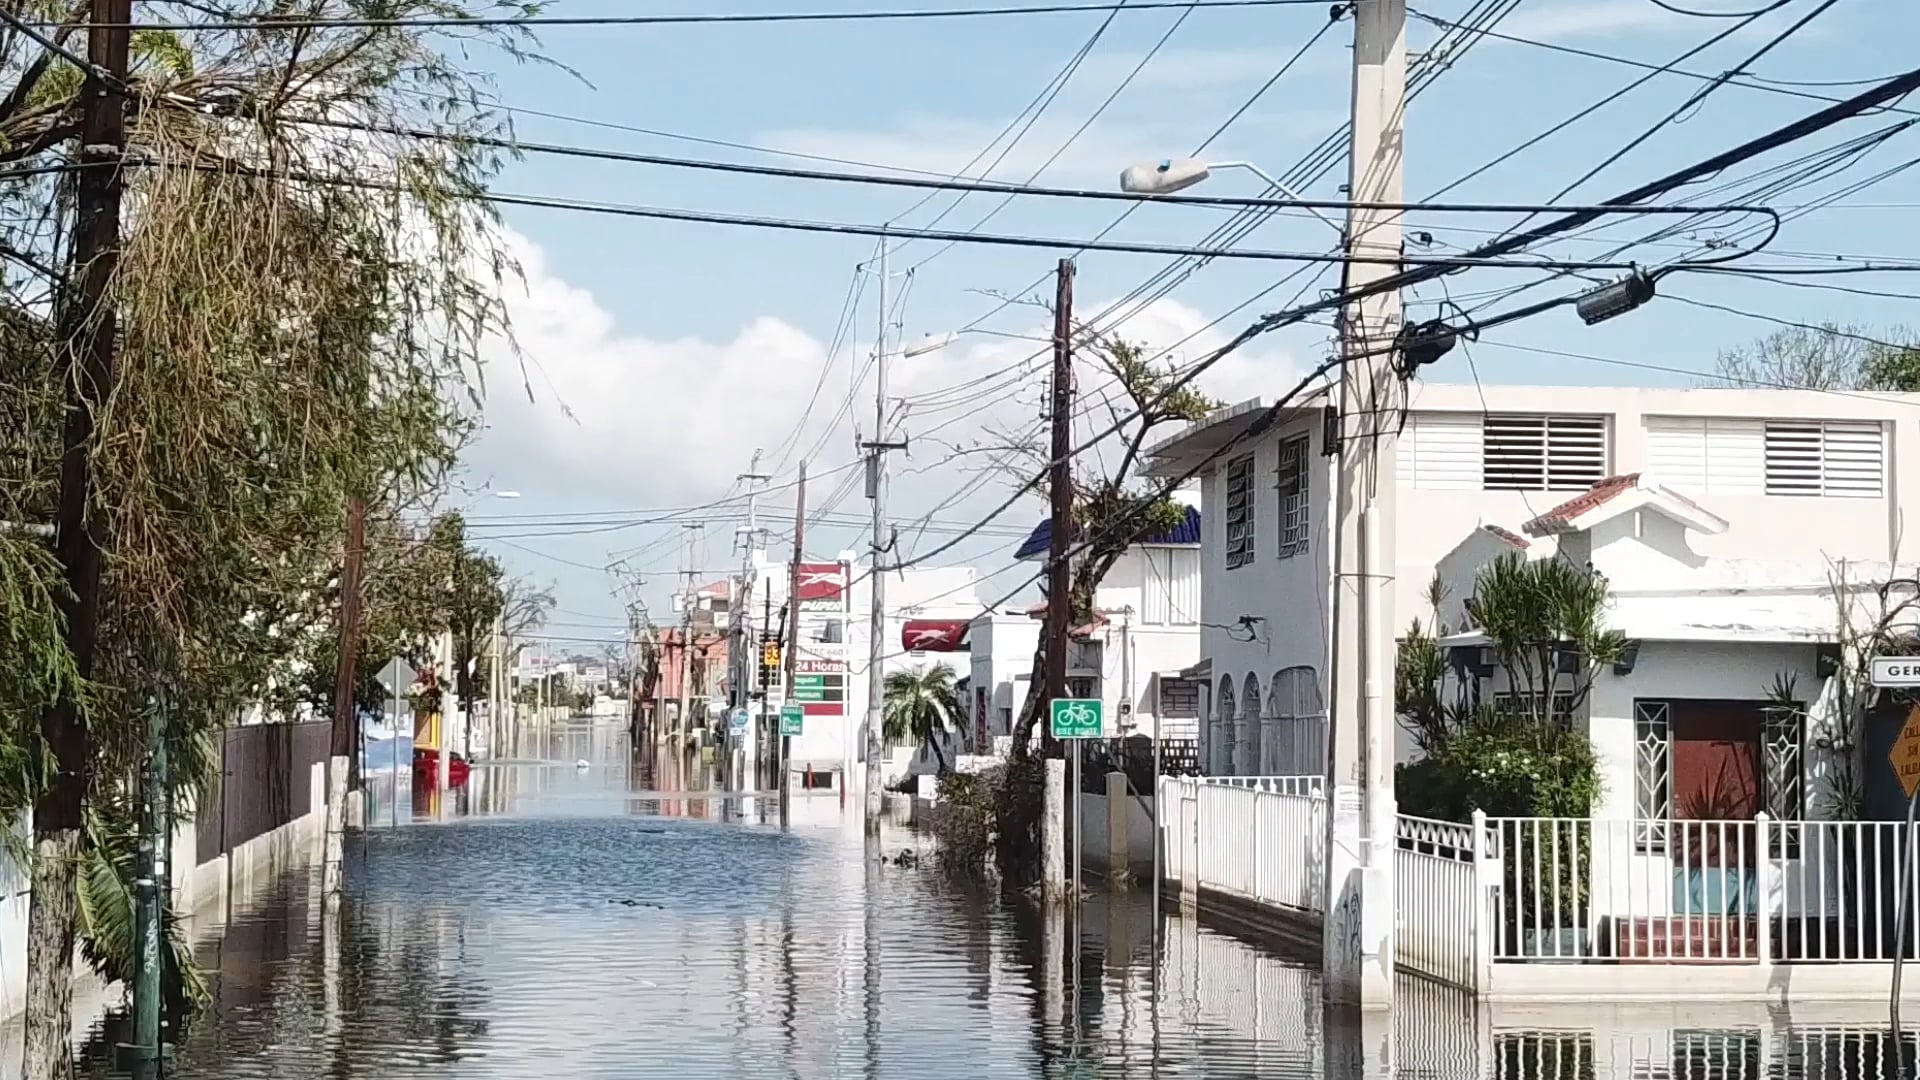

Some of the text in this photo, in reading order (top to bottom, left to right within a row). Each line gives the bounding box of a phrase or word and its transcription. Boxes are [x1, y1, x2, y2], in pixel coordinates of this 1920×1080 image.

[795, 661, 809, 671] 24
[1887, 665, 1920, 676] GER
[1056, 727, 1098, 735] BIKE ROUTE
